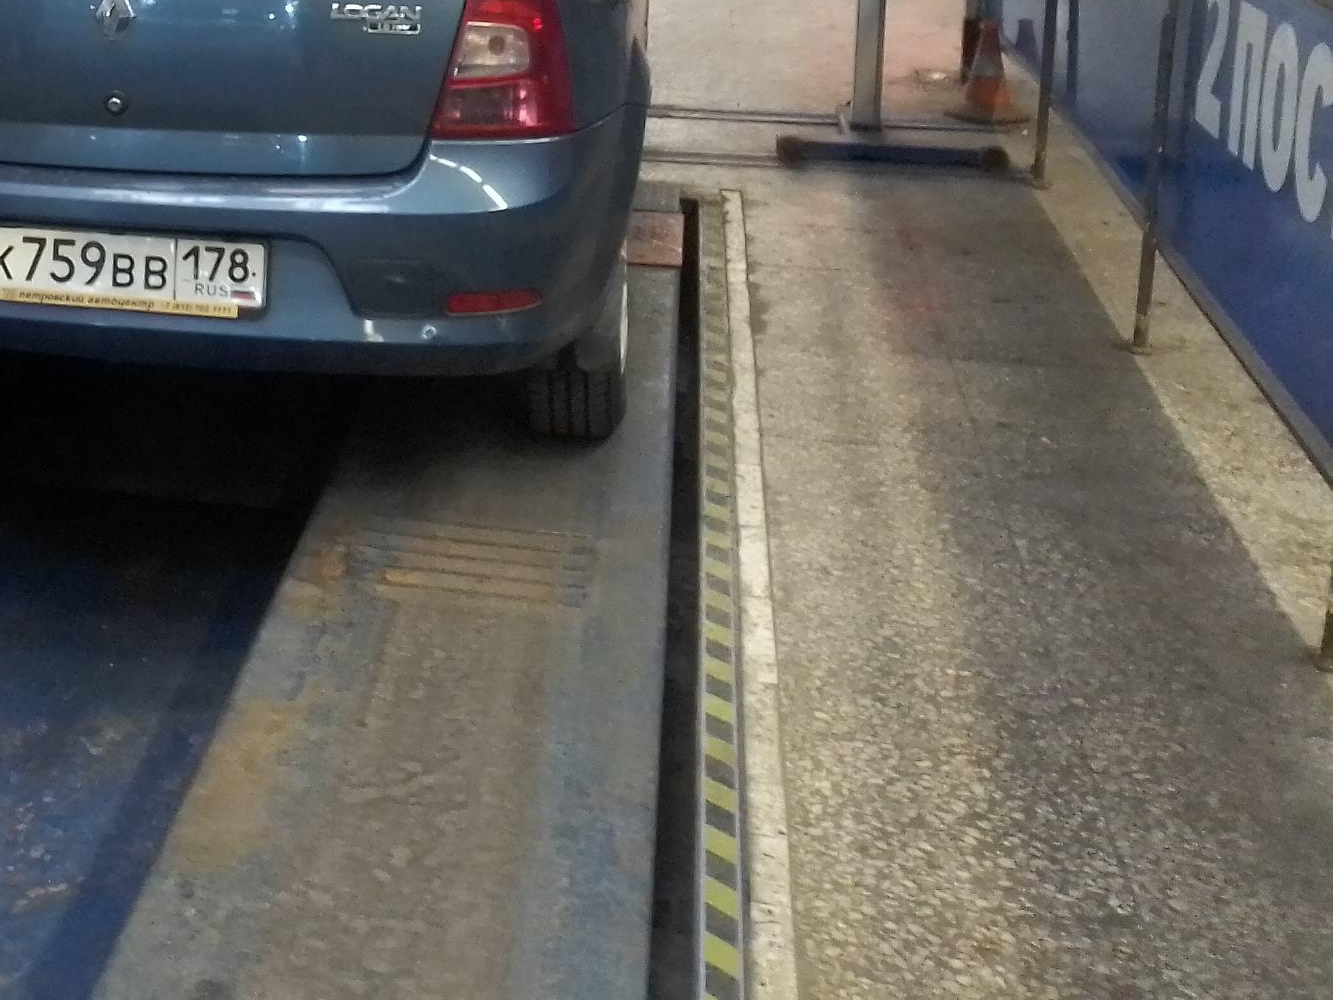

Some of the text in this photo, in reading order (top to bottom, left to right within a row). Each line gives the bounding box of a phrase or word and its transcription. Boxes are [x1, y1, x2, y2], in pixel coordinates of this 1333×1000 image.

[331, 2, 423, 22] LOGAN
[1227, 0, 1333, 240] ПОС
[182, 246, 250, 283] 178
[193, 282, 230, 298] RUS
